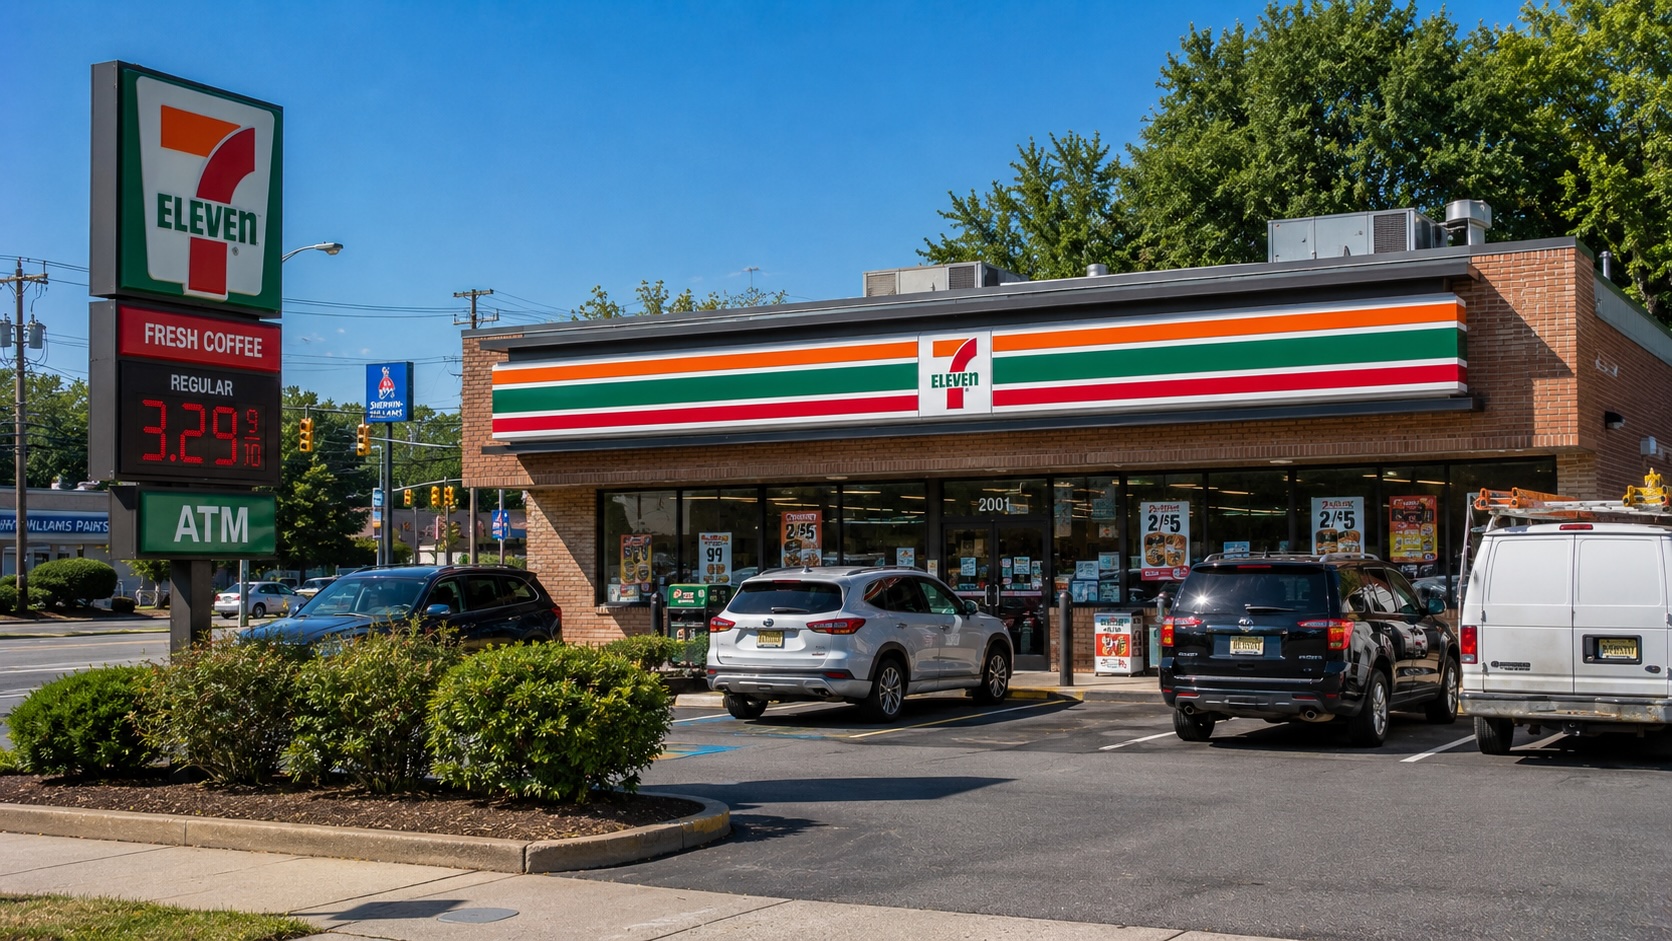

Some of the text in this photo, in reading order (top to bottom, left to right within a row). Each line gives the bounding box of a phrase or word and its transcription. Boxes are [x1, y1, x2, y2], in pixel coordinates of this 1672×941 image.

[161, 104, 255, 296] 7
[144, 322, 263, 358] FRESH COFFEE
[170, 373, 233, 396] REGULAR
[932, 337, 977, 410] 7
[142, 399, 238, 466] 3.29
[246, 408, 258, 433] 9
[978, 497, 1010, 512] 2001
[173, 505, 249, 543] ATM
